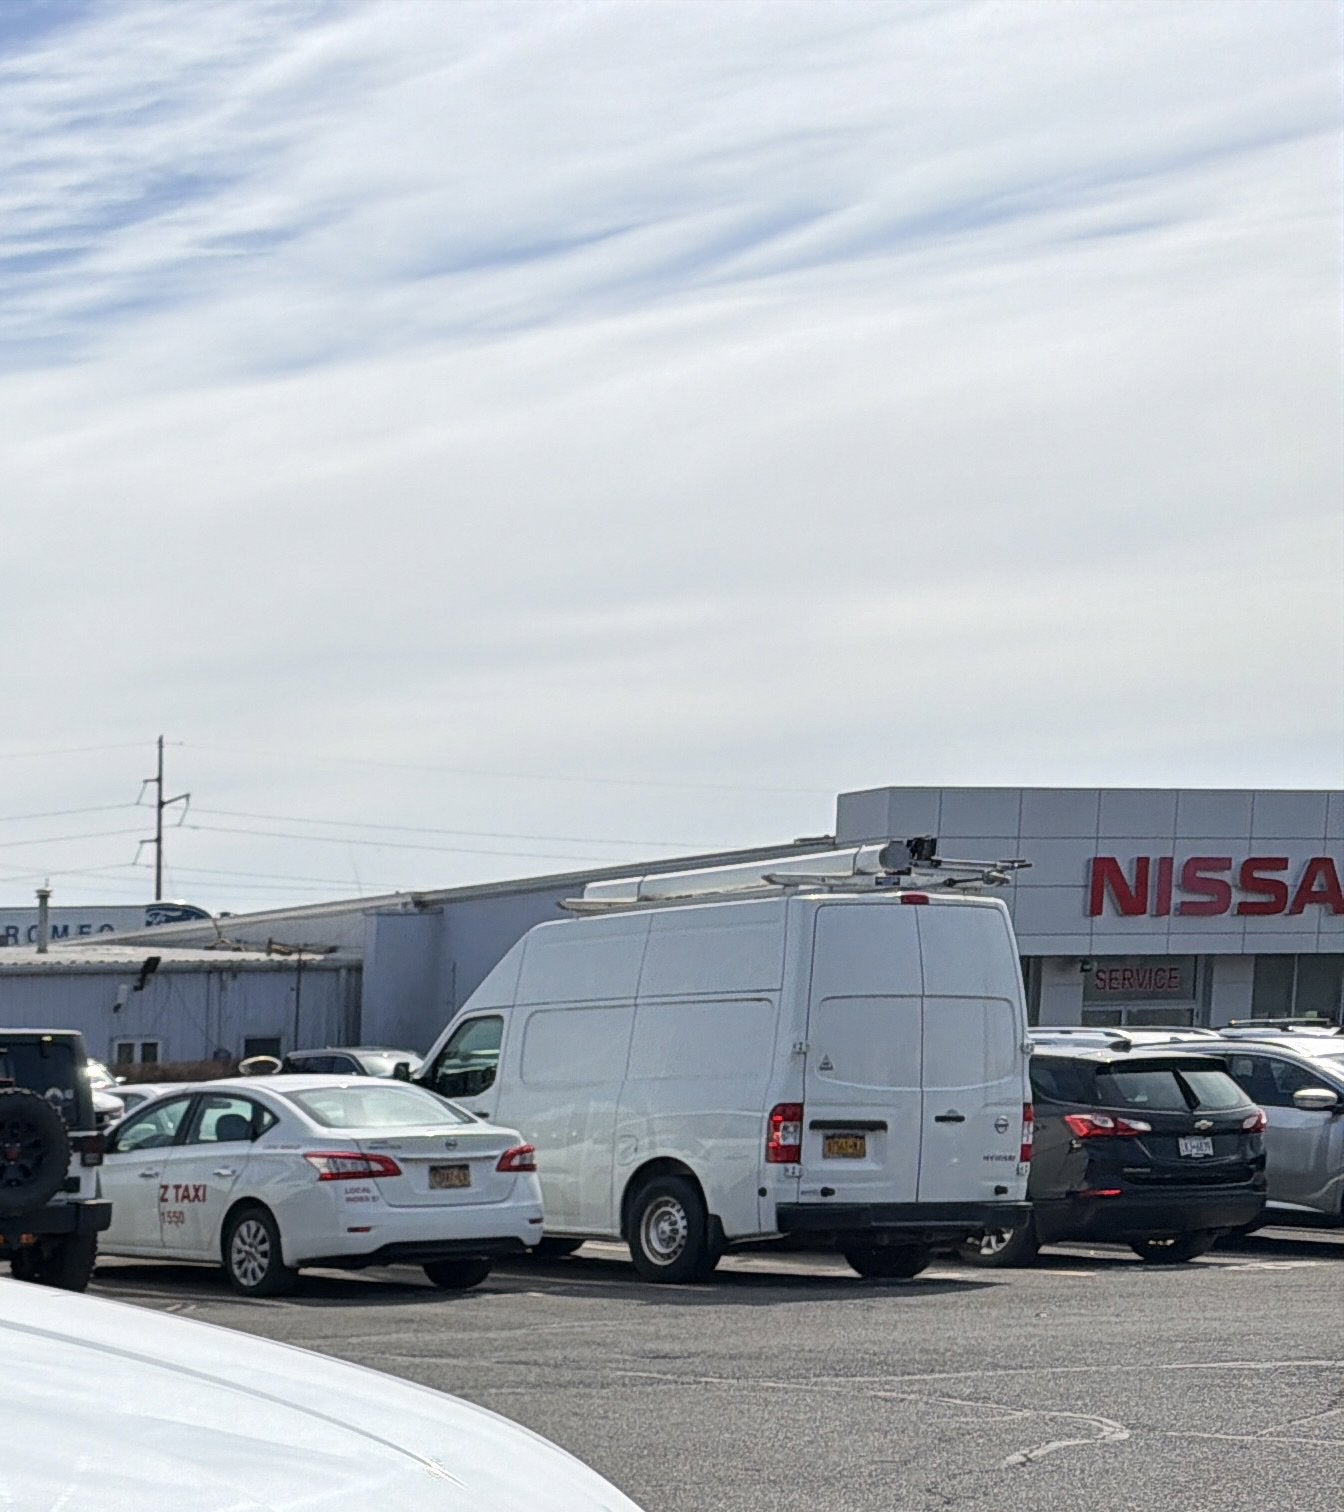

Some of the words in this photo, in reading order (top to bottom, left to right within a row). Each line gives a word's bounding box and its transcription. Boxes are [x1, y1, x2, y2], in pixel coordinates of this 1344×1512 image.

[1095, 967, 1180, 991] SERVICE
[160, 1184, 169, 1203] Z
[172, 1184, 207, 1203] TAXI
